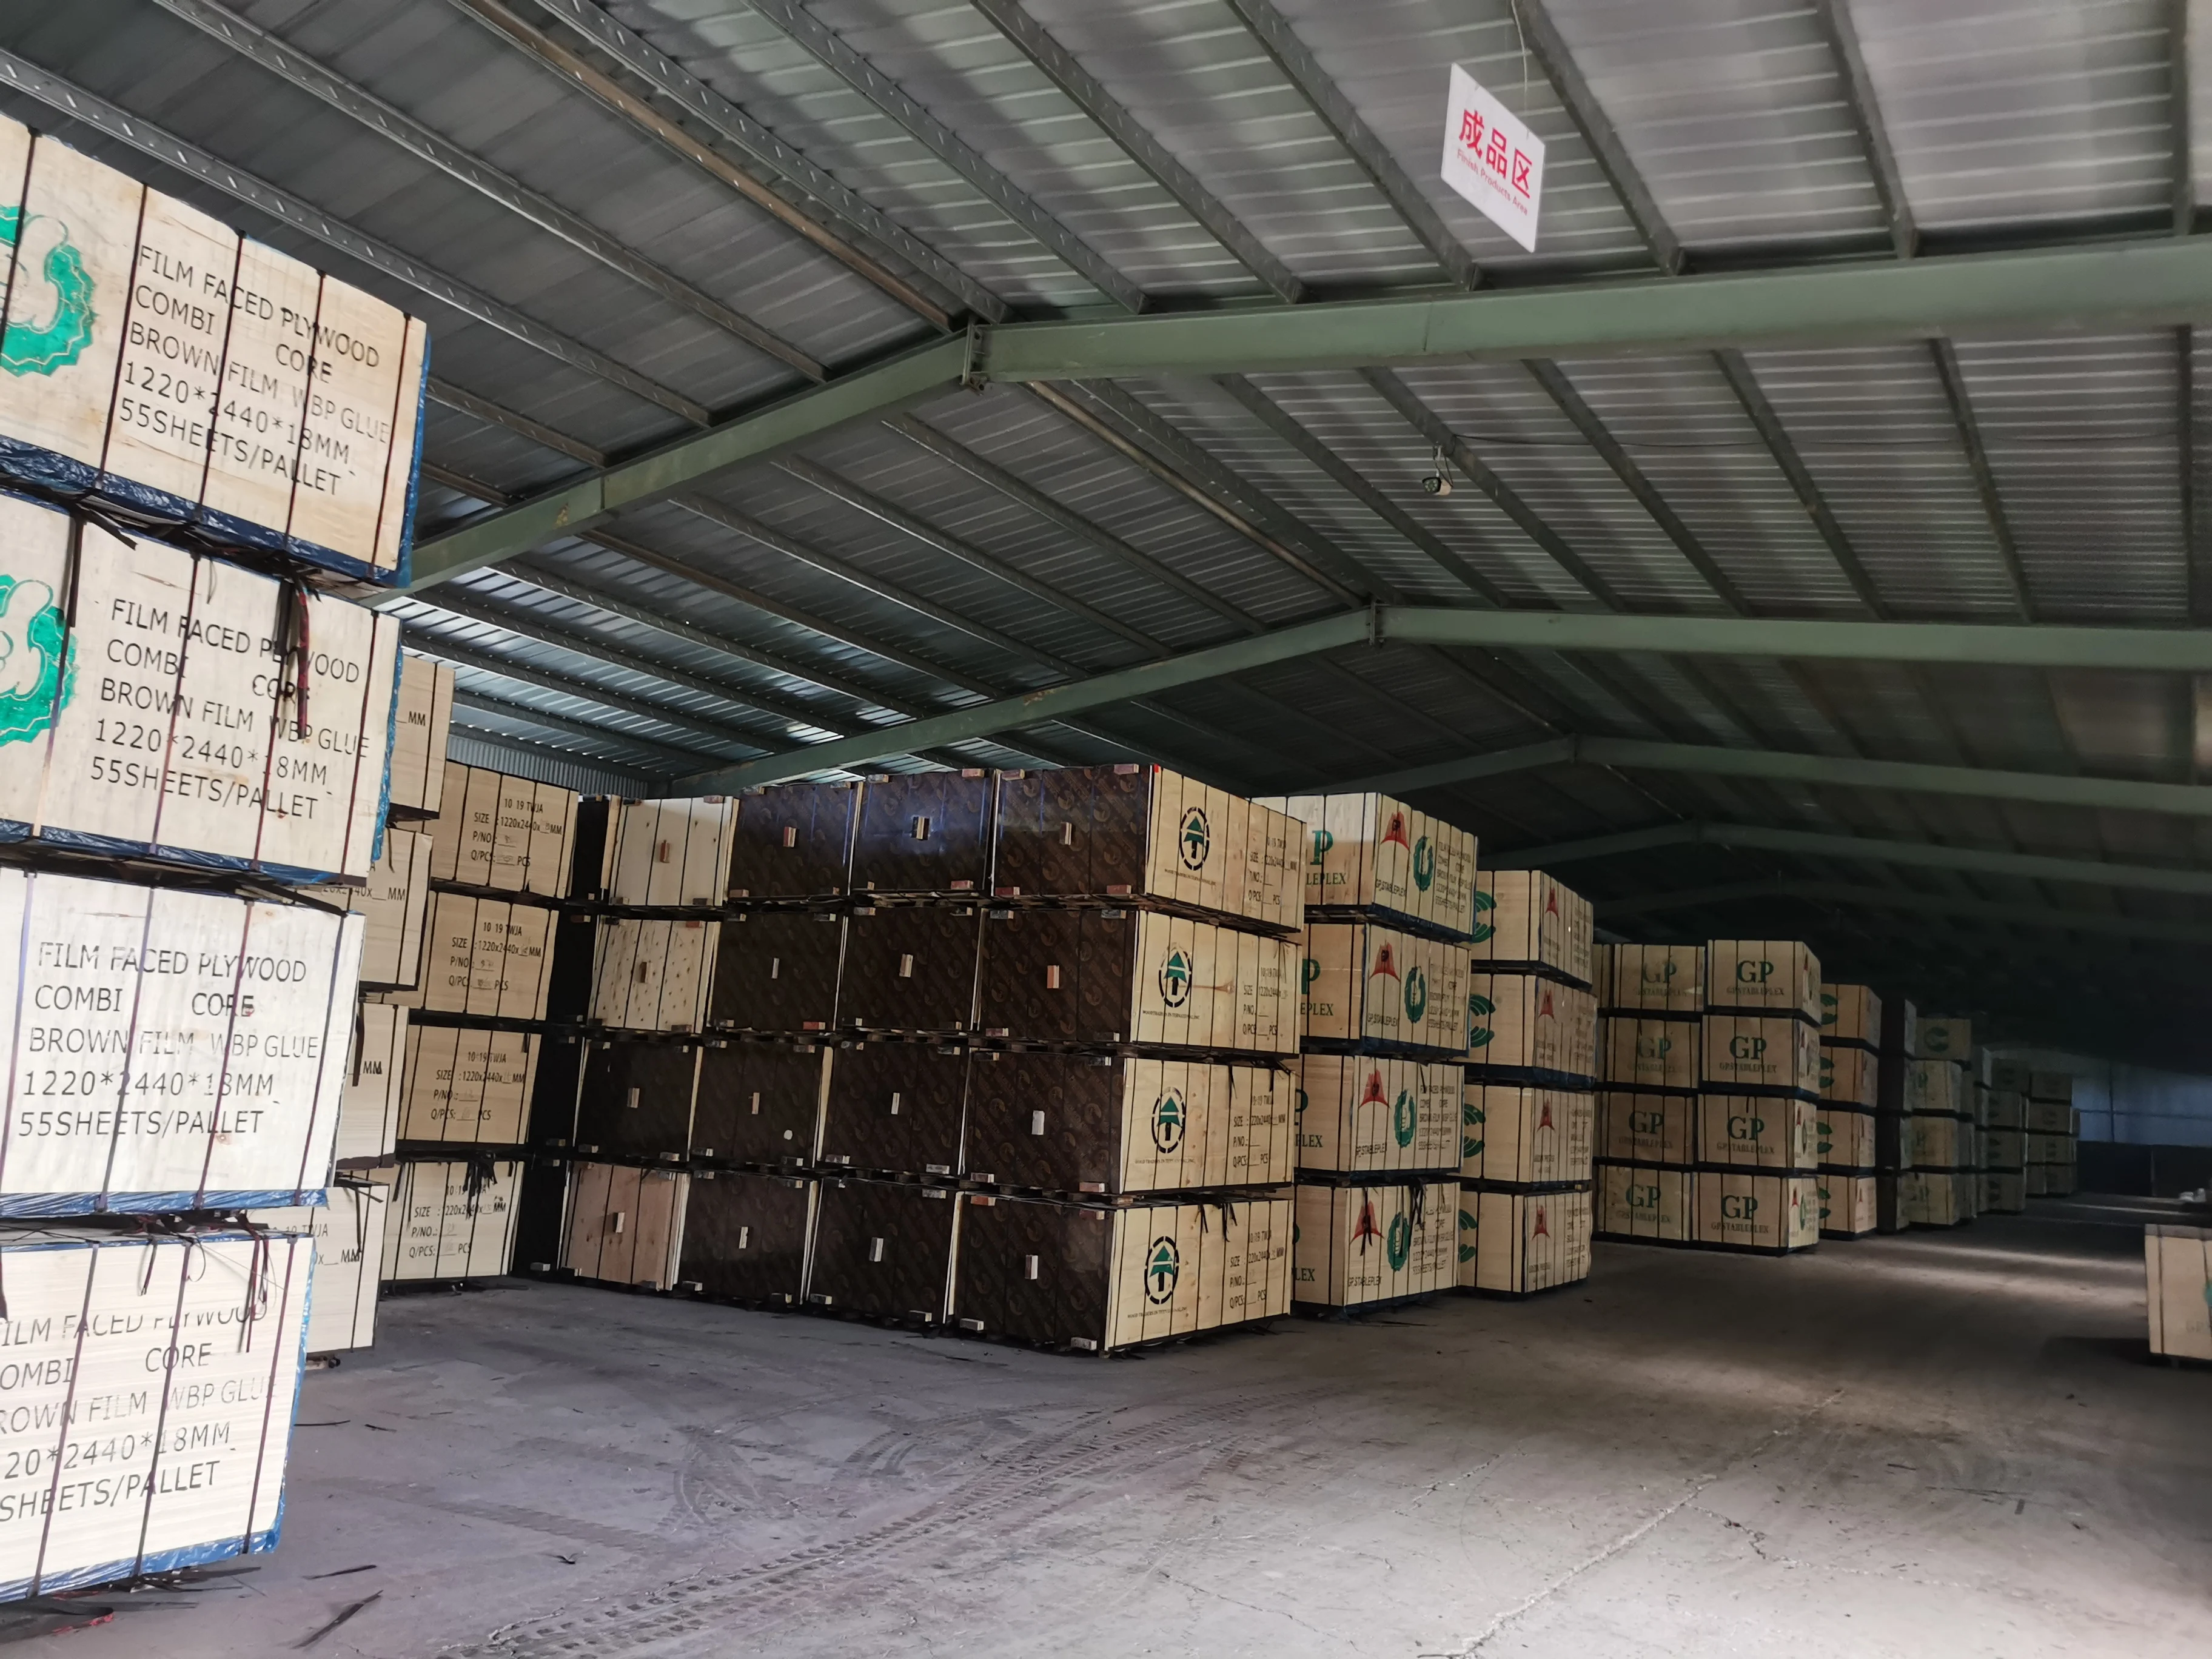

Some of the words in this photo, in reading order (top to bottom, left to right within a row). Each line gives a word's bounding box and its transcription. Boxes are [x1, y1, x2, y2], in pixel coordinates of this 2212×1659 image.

[1459, 109, 1532, 199] 成品区
[1456, 148, 1478, 175] Finish
[1480, 168, 1511, 202] Products
[1512, 196, 1528, 216] Area
[138, 245, 193, 288] FILM
[204, 273, 273, 320] FACED
[280, 307, 380, 367] PLYWOOD
[135, 285, 215, 335] COMBI
[276, 343, 333, 383] CORE
[130, 322, 220, 376] BROWN
[228, 362, 278, 400] FILM
[292, 385, 335, 420] WBP
[341, 408, 390, 443] GLUE
[112, 598, 167, 633] FILM
[178, 616, 250, 654] FACED
[260, 638, 360, 683] PLOOD
[107, 639, 189, 679] COMBI
[101, 678, 193, 719] BROWN
[203, 701, 253, 732] FILM
[318, 728, 369, 758] GLUE
[96, 718, 327, 785] 122024408MM
[90, 756, 318, 819] 55SHEETS/PALLET
[474, 812, 489, 823] SIZE
[452, 937, 468, 948] SIZE
[38, 942, 99, 970] FILM
[110, 946, 188, 974] FACED
[198, 953, 306, 982] PLYWOOD
[1737, 960, 1774, 983] GP
[35, 985, 122, 1012] COMBI
[192, 992, 255, 1017] CORE
[29, 1027, 128, 1053] BROWN
[139, 1031, 194, 1055] FILM
[211, 1032, 258, 1057] WBP
[264, 1035, 319, 1059] GLUE
[1729, 1036, 1767, 1060] GP
[436, 1069, 452, 1080] SIZE
[18, 1110, 264, 1139] 55SHEETS/PALLET
[1629, 1111, 1664, 1134] GP
[1727, 1116, 1765, 1140] GP
[1717, 1141, 1775, 1154] GPTABLELEX
[1626, 1184, 1661, 1208] GP
[1721, 1195, 1758, 1220] GP
[414, 1206, 431, 1218] SIZE
[62, 1313, 143, 1339] FACED
[146, 1342, 212, 1373] CORE
[89, 1390, 148, 1423] FILM
